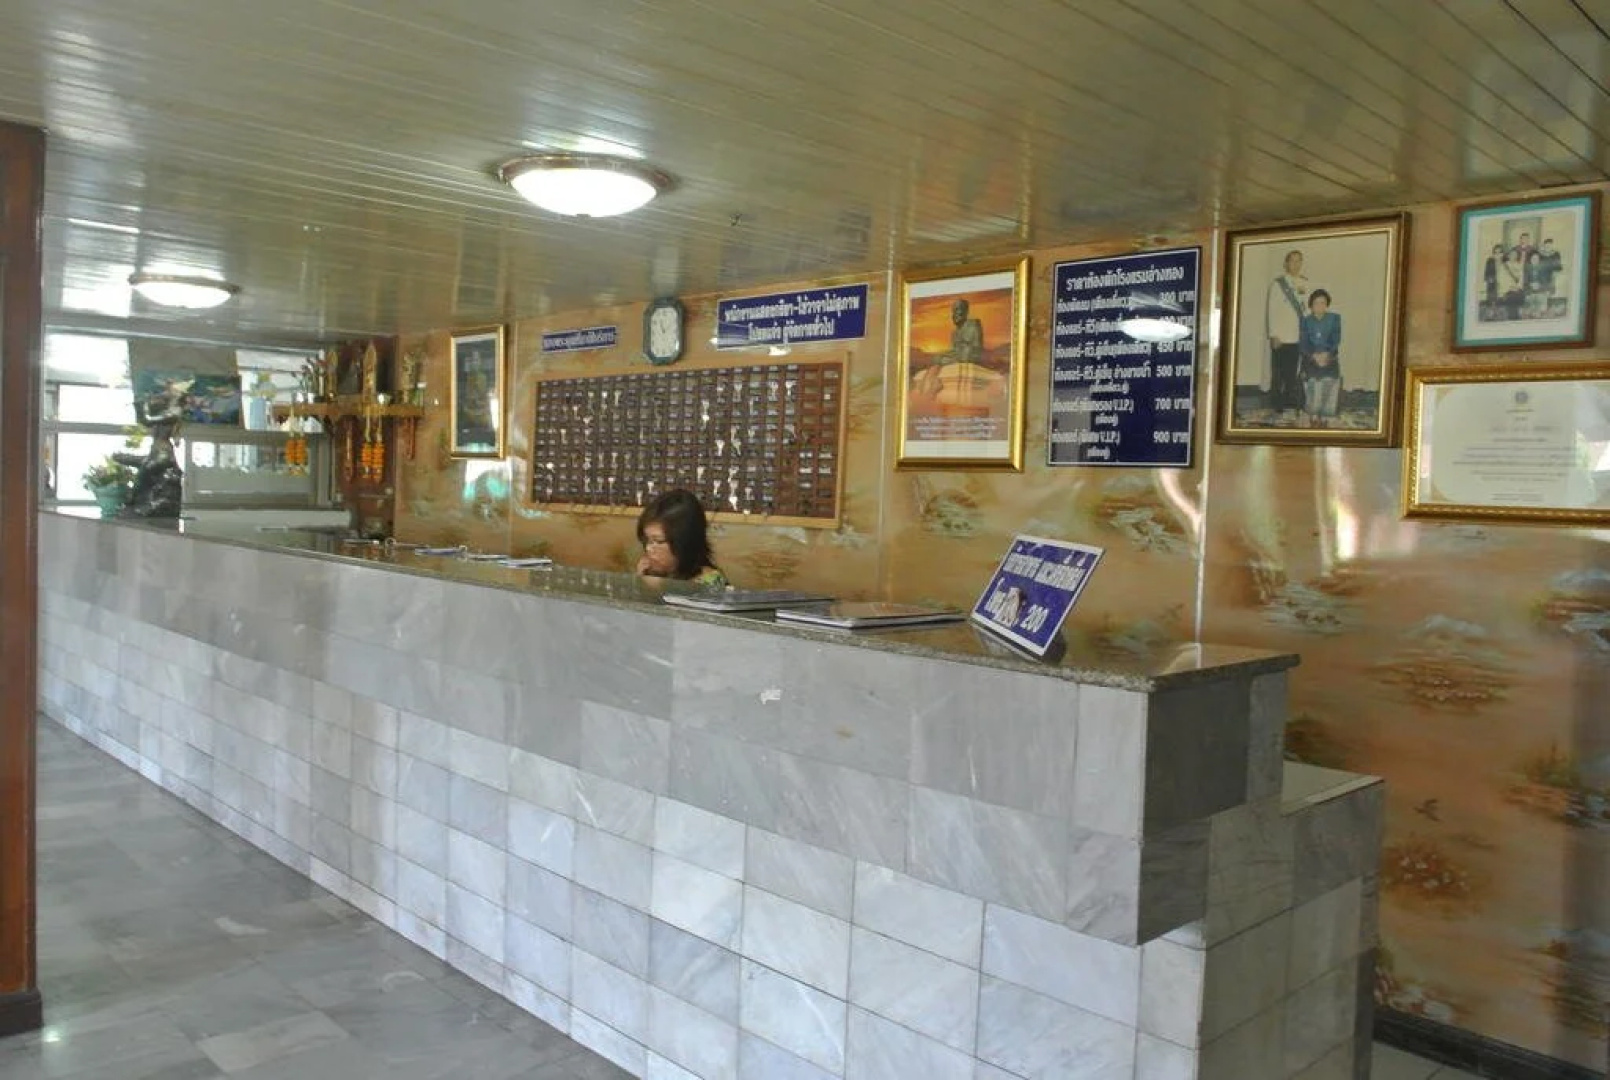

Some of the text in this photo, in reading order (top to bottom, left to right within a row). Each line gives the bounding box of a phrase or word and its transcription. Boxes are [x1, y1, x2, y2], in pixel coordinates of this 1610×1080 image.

[1157, 340, 1174, 353] 450
[1175, 340, 1193, 352] บาท
[1156, 365, 1173, 377] 500
[1175, 364, 1192, 377] บาท
[1154, 397, 1171, 410] 700
[1173, 397, 1191, 410] บาท
[1153, 431, 1170, 443] 900
[1172, 430, 1190, 443] บาท
